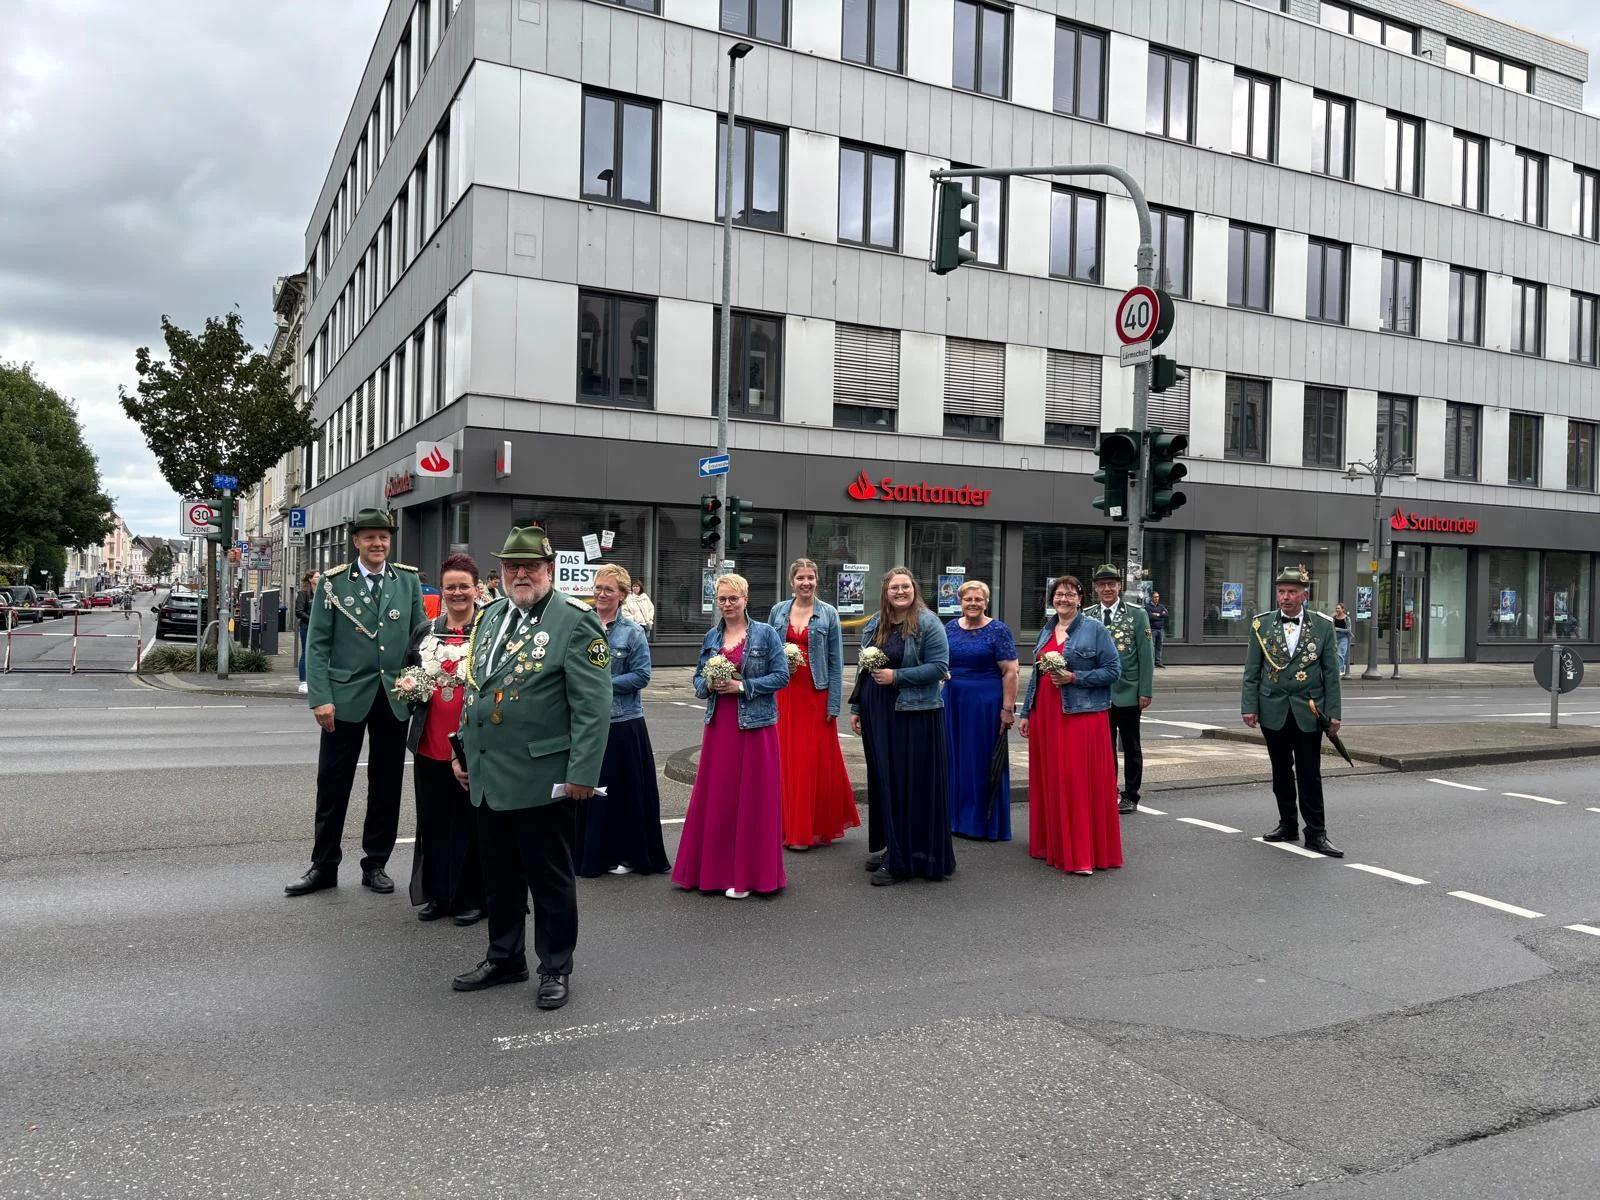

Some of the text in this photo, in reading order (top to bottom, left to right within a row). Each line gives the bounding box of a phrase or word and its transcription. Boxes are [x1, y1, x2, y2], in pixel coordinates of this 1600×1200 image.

[1124, 301, 1150, 330] 40
[1122, 348, 1149, 360] Lärmschutz
[880, 477, 992, 506] Santander
[194, 510, 209, 521] 30
[291, 511, 301, 524] P
[1410, 511, 1479, 534] Santander
[242, 543, 249, 553] P
[560, 554, 580, 565] DAS
